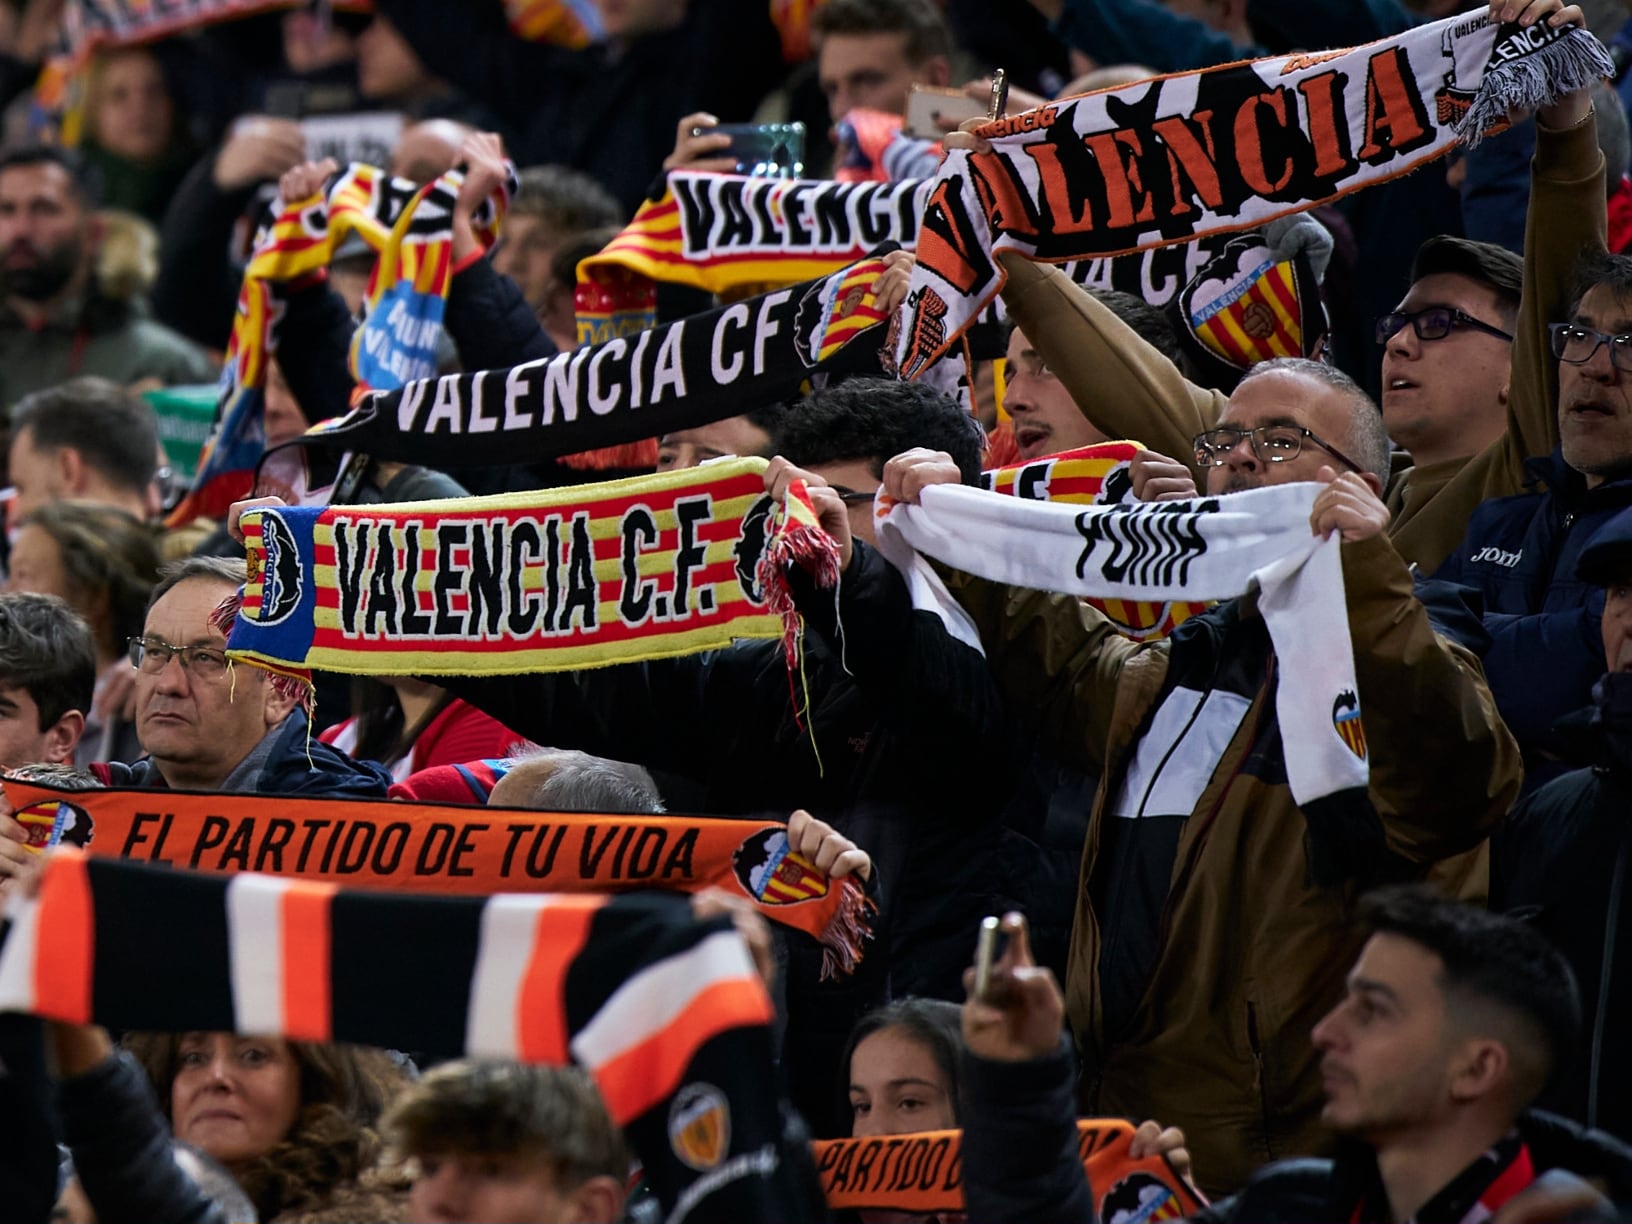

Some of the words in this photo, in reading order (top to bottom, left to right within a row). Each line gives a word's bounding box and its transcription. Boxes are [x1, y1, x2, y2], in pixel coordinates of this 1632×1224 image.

[398, 320, 688, 435] VALENCIA
[711, 290, 792, 386] CF
[335, 512, 599, 641] VALENCIA
[618, 494, 719, 625] C.F.
[191, 816, 411, 877] PARTIDO
[416, 821, 476, 879] DE
[490, 824, 571, 880] TU
[578, 826, 699, 881] VIDA
